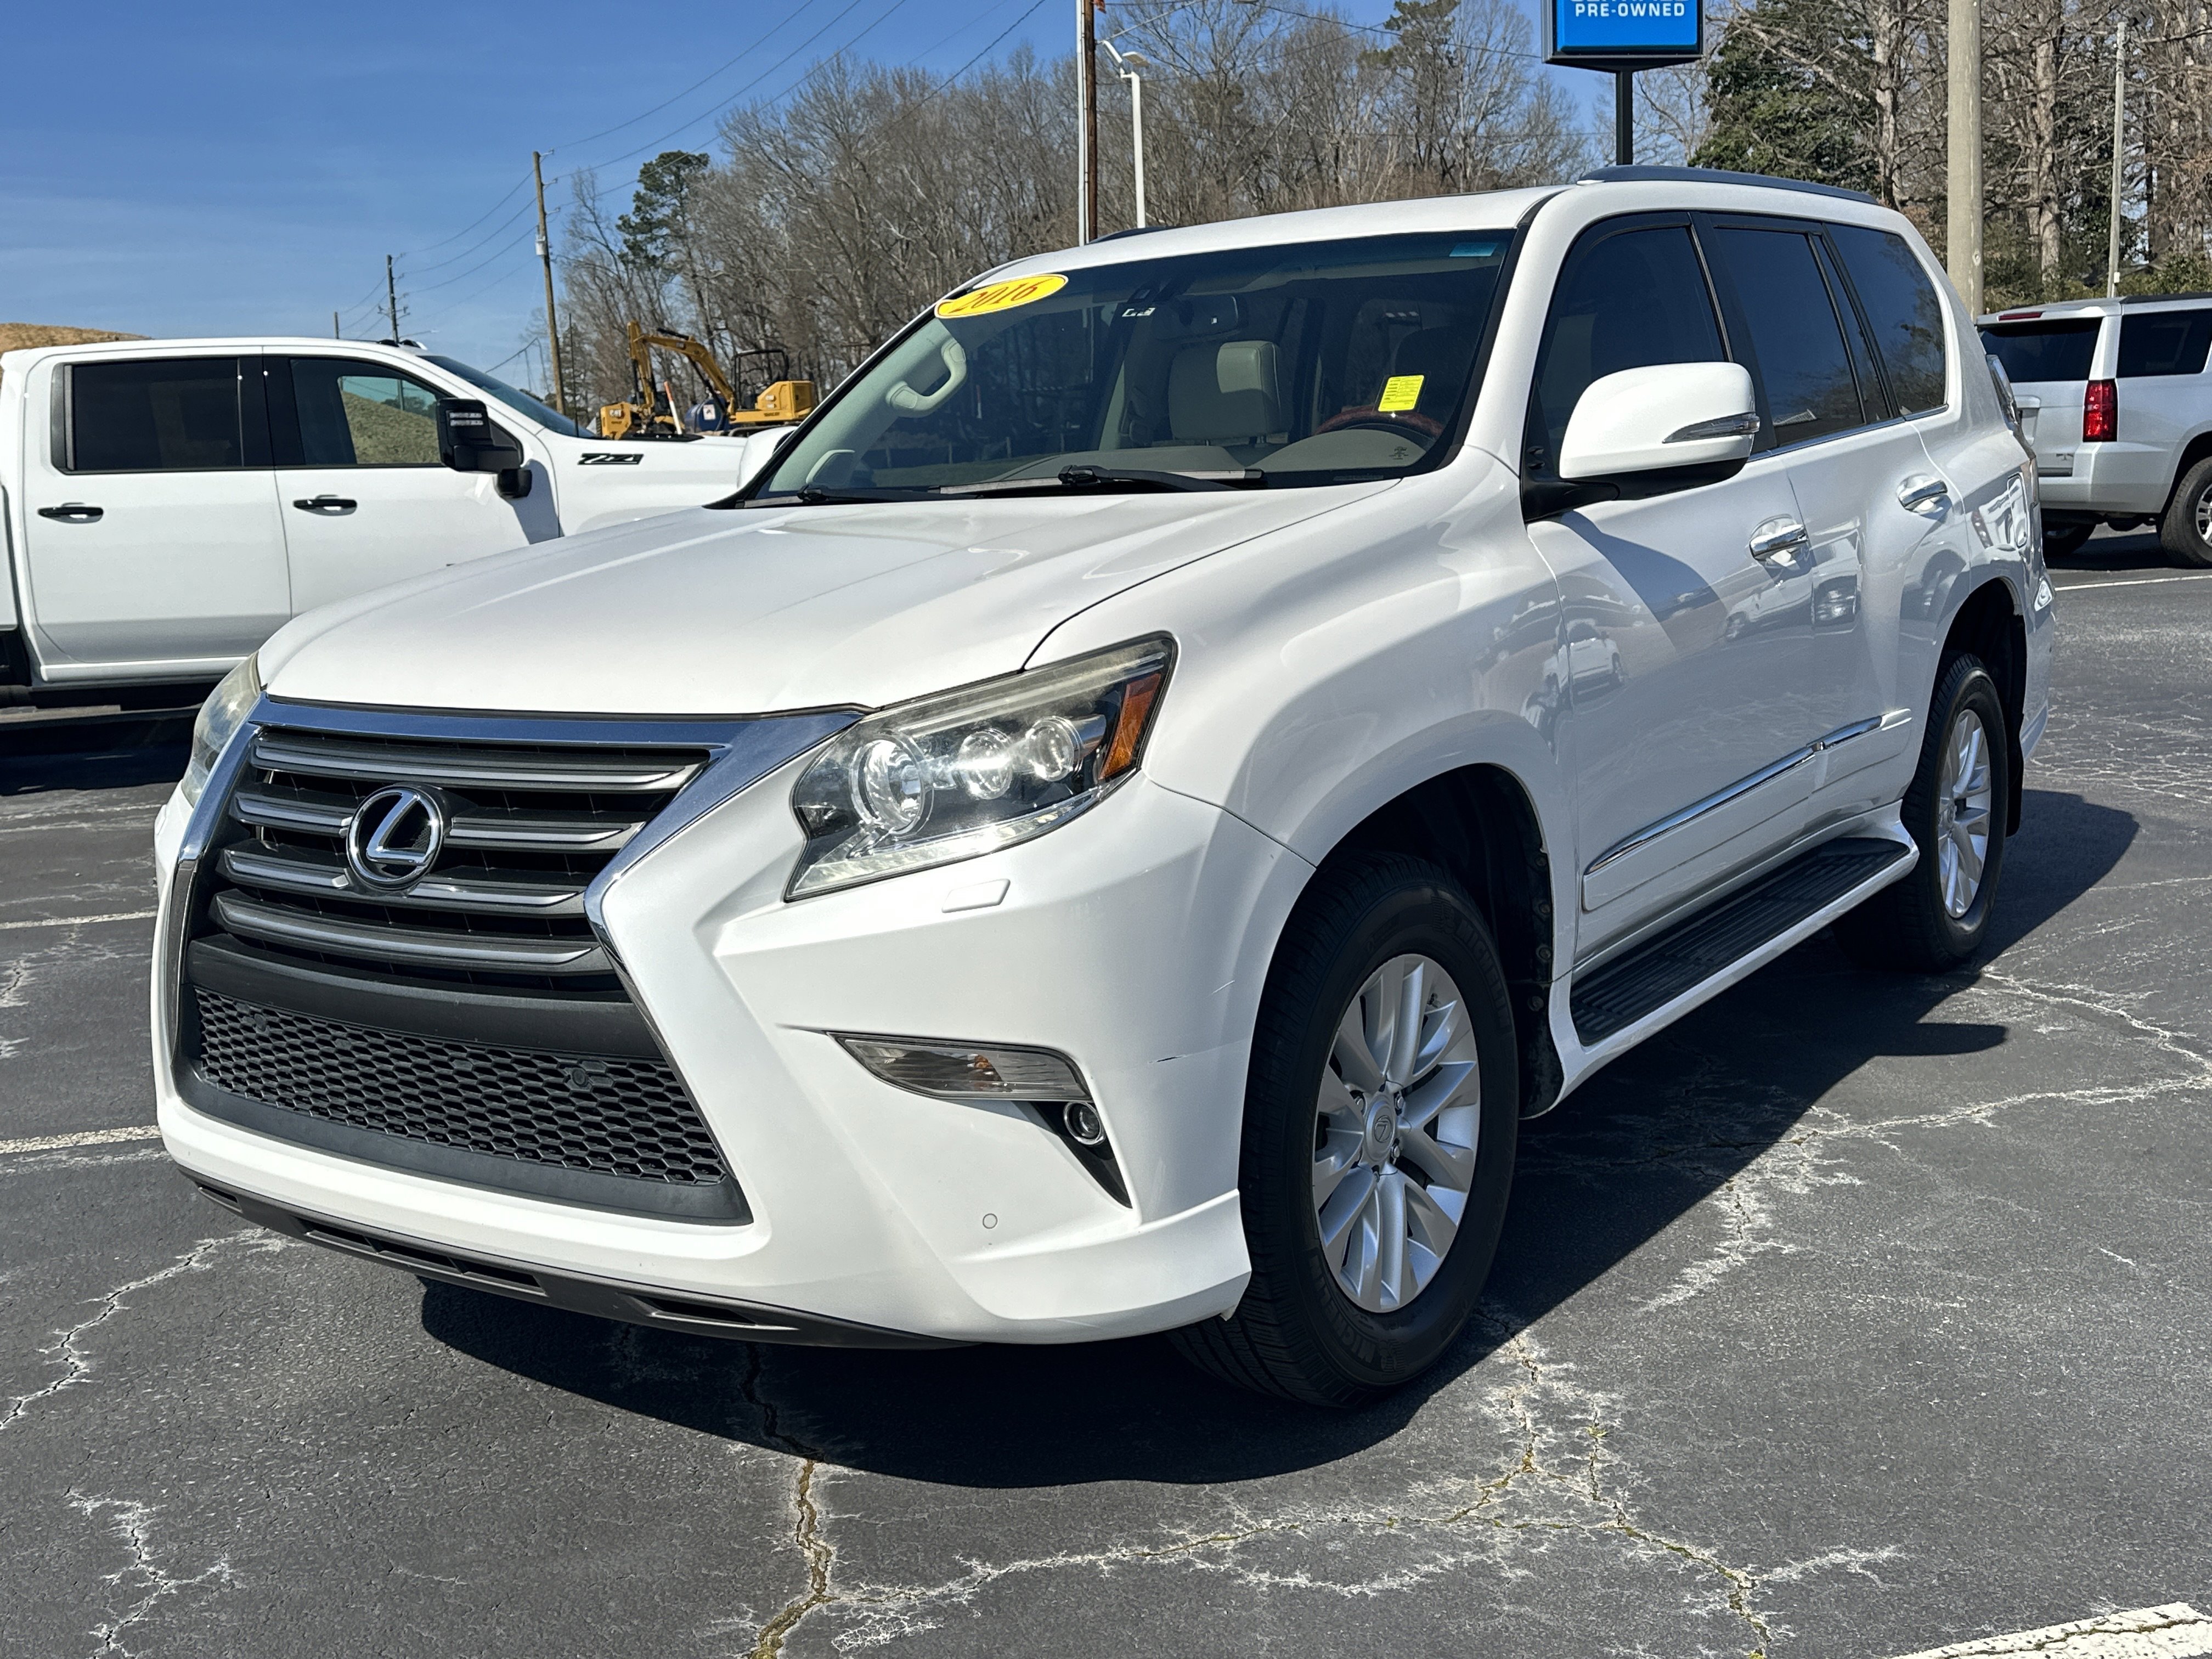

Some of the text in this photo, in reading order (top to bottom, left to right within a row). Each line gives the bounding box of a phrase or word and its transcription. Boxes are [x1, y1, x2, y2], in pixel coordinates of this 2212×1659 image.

[1575, 3, 1685, 17] PRE-OWNED
[947, 278, 1054, 314] 2016
[577, 453, 644, 465] Z71
[1455, 918, 1510, 1029] MICHELIN
[1308, 1253, 1376, 1363] MICHELIN
